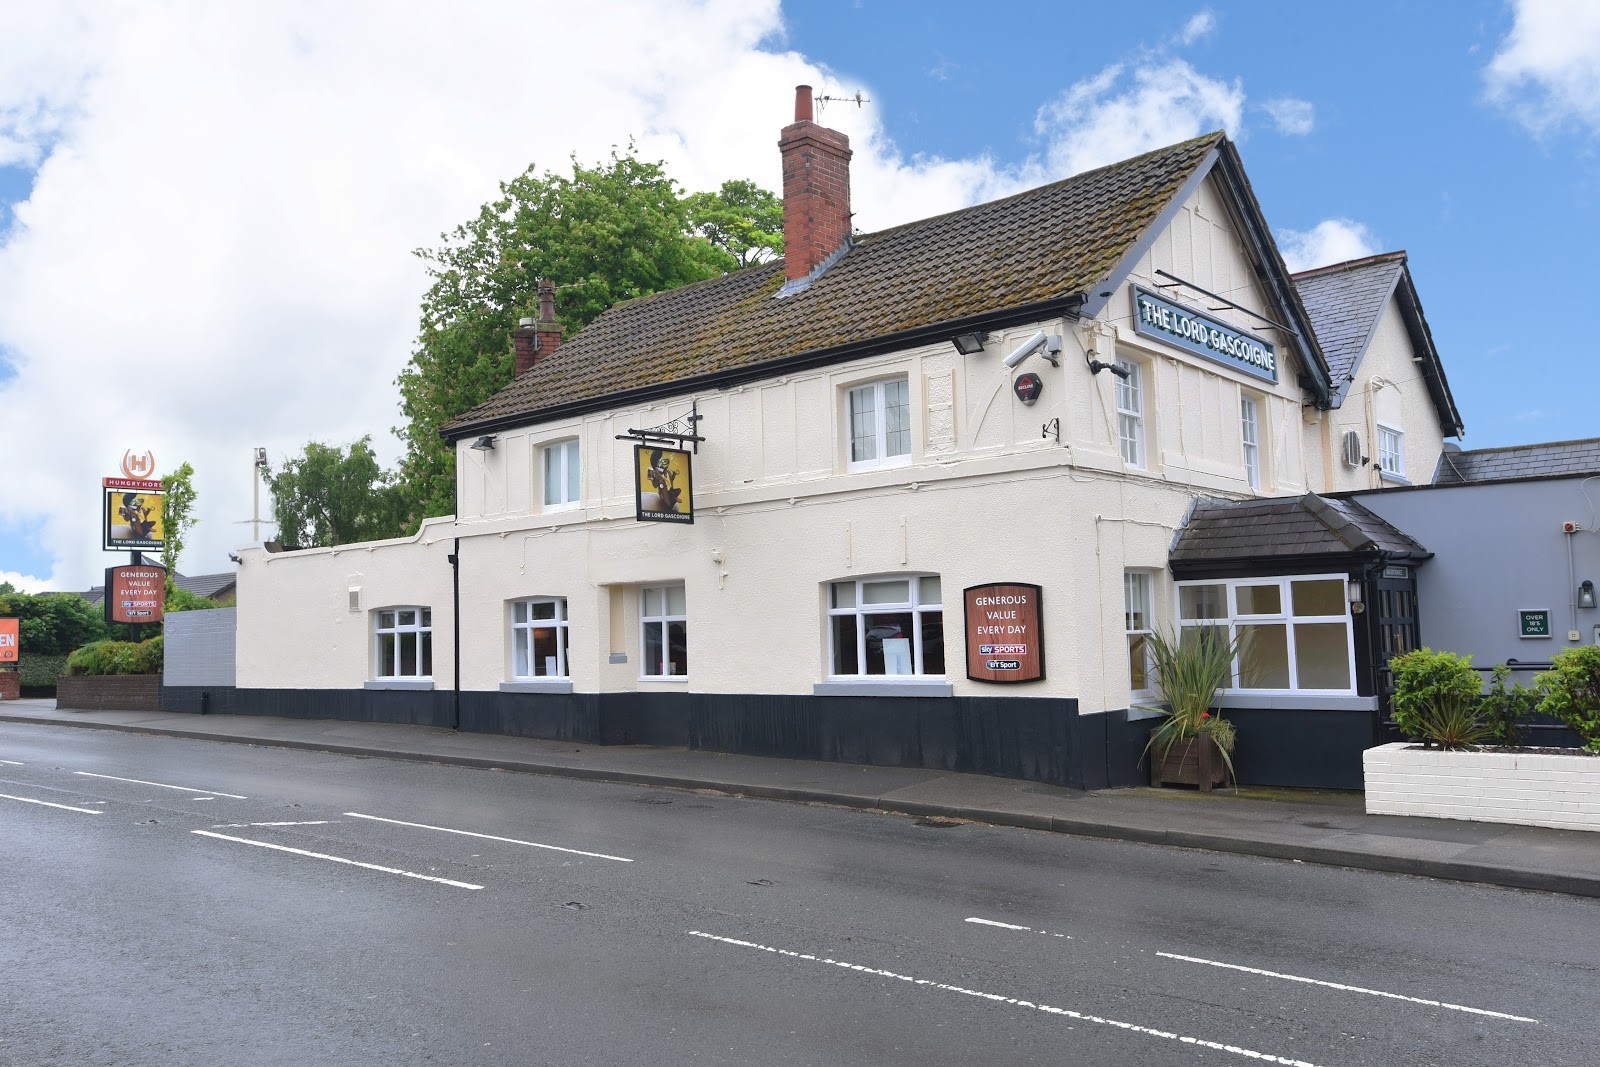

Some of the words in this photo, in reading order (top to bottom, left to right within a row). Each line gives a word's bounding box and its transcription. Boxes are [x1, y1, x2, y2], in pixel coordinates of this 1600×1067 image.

[1142, 300, 1170, 330] THE
[1173, 313, 1208, 344] LORD
[1210, 329, 1275, 371] GASCOIGNE
[109, 479, 141, 487] HUNGRY
[975, 595, 1027, 606] GENEROUS
[986, 611, 1016, 620] VALUE
[977, 625, 1006, 635] EVERY
[1007, 625, 1027, 634] DAY
[981, 645, 993, 654] sky
[994, 645, 1025, 653] SPORTS
[1000, 661, 1017, 669] Sport
